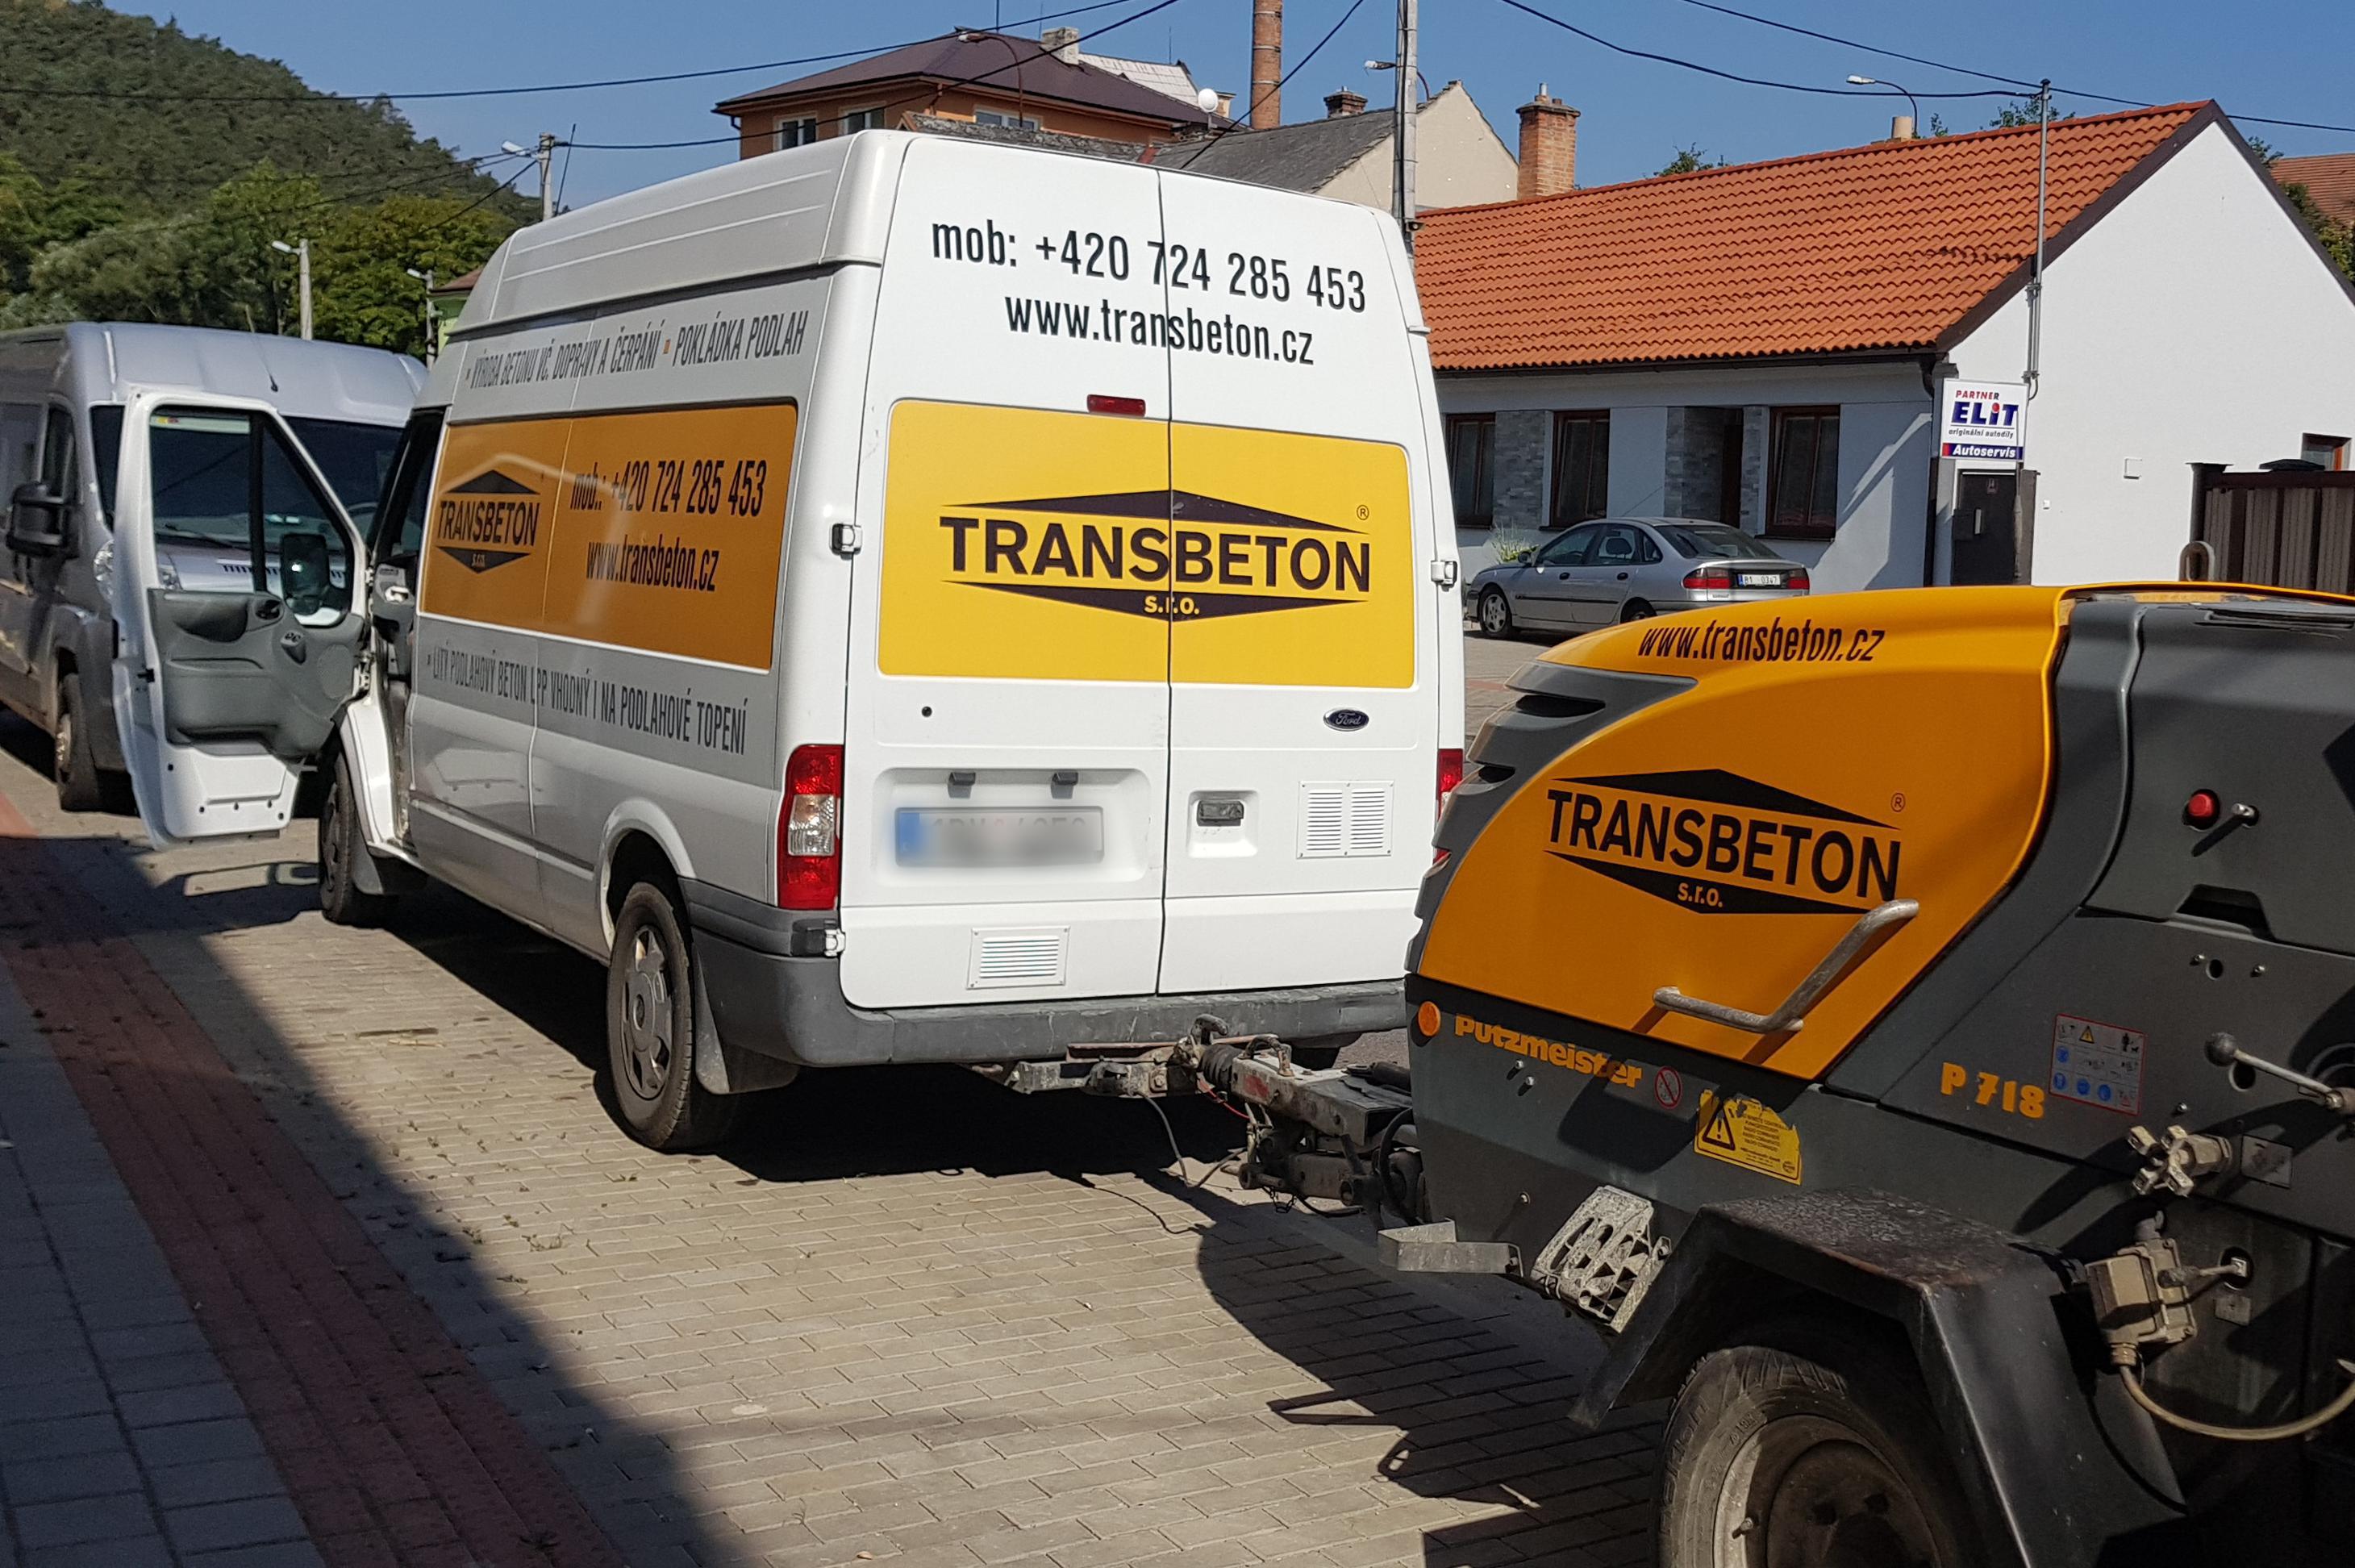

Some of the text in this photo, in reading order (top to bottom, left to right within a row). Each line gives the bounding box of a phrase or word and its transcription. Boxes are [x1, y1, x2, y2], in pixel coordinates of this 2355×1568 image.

[932, 219, 1365, 313] mob: +420 724 285 453
[552, 339, 602, 381] DOPRAVY
[596, 338, 610, 375] A
[610, 319, 665, 374] ČERPÁNÍ
[672, 311, 744, 366] POKLÁDKA
[744, 311, 809, 360] PODLAH
[1005, 296, 1315, 365] www.transbeton.cz
[1956, 390, 1999, 400] PARTNER
[1953, 444, 2015, 457] Autoservis
[611, 461, 650, 511] +420
[652, 460, 685, 513] 724
[686, 459, 725, 514] 285
[728, 460, 767, 517] 453
[437, 500, 540, 547] TRANSBETON
[586, 534, 720, 591] www.transbeton.cz
[940, 516, 1370, 592] TRANSBETON
[1638, 617, 1886, 661] www.transbeton.cz
[498, 661, 527, 703] BETON
[551, 668, 590, 717] VHODNÝ
[601, 682, 616, 724] NA
[619, 688, 691, 742] PODLAHOVÉ
[697, 698, 748, 755] TOPENÍ
[1336, 713, 1361, 724] Ford
[1547, 789, 1901, 902] TRANSBETON
[1455, 1015, 1642, 1088] Putzmeister
[1940, 1061, 2045, 1119] P 718
